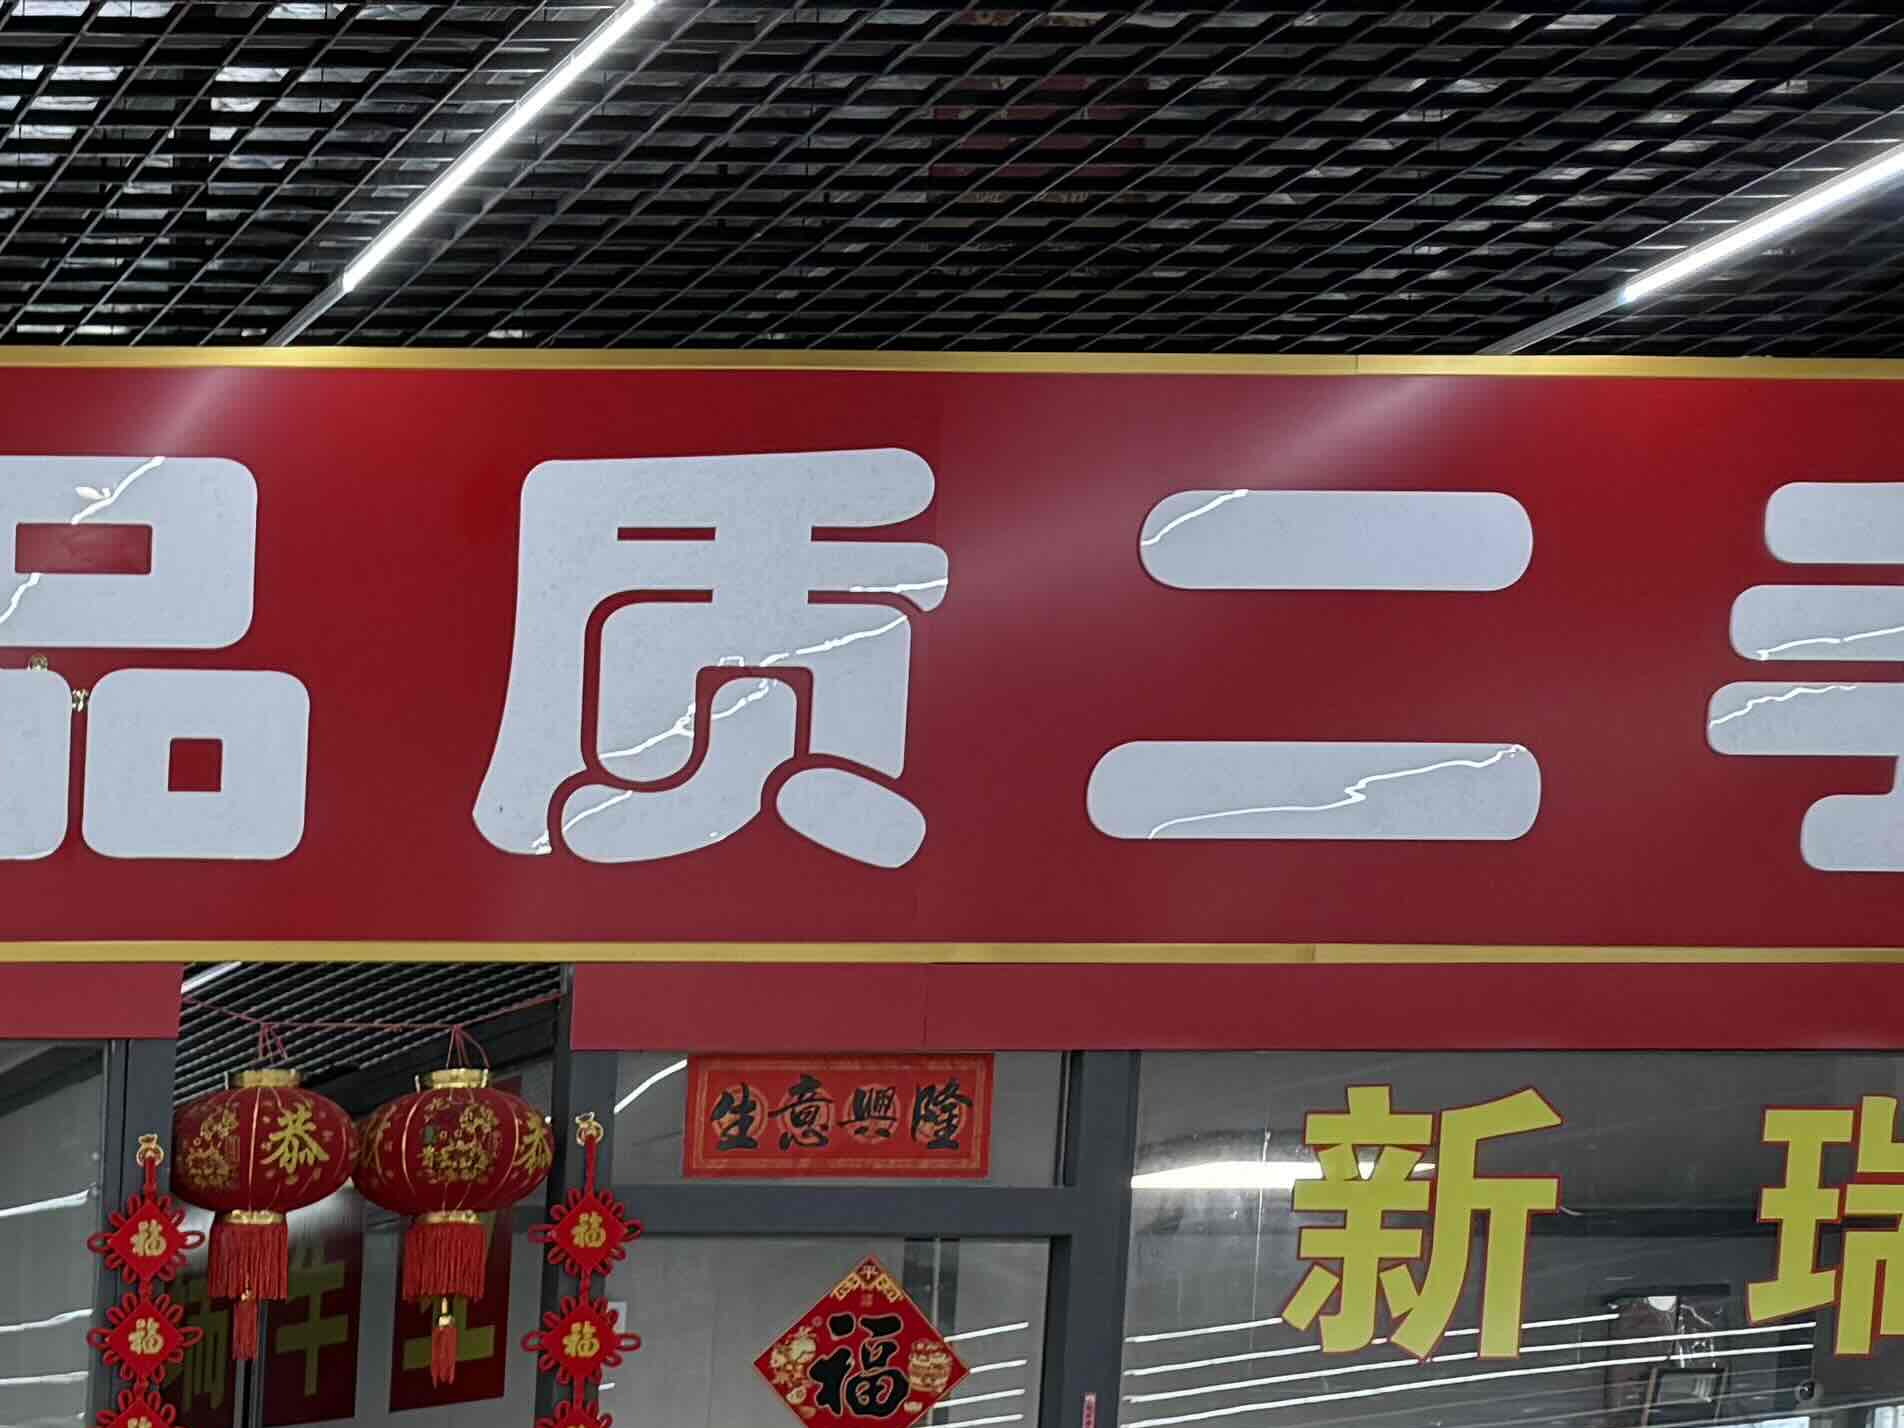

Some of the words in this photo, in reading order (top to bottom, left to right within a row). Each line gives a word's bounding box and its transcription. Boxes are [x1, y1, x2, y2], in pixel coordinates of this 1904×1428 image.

[130, 1219, 166, 1256] 福
[571, 1212, 605, 1248] 福
[129, 1317, 164, 1354] 福
[563, 1321, 599, 1357] 福
[807, 1312, 910, 1418] 福
